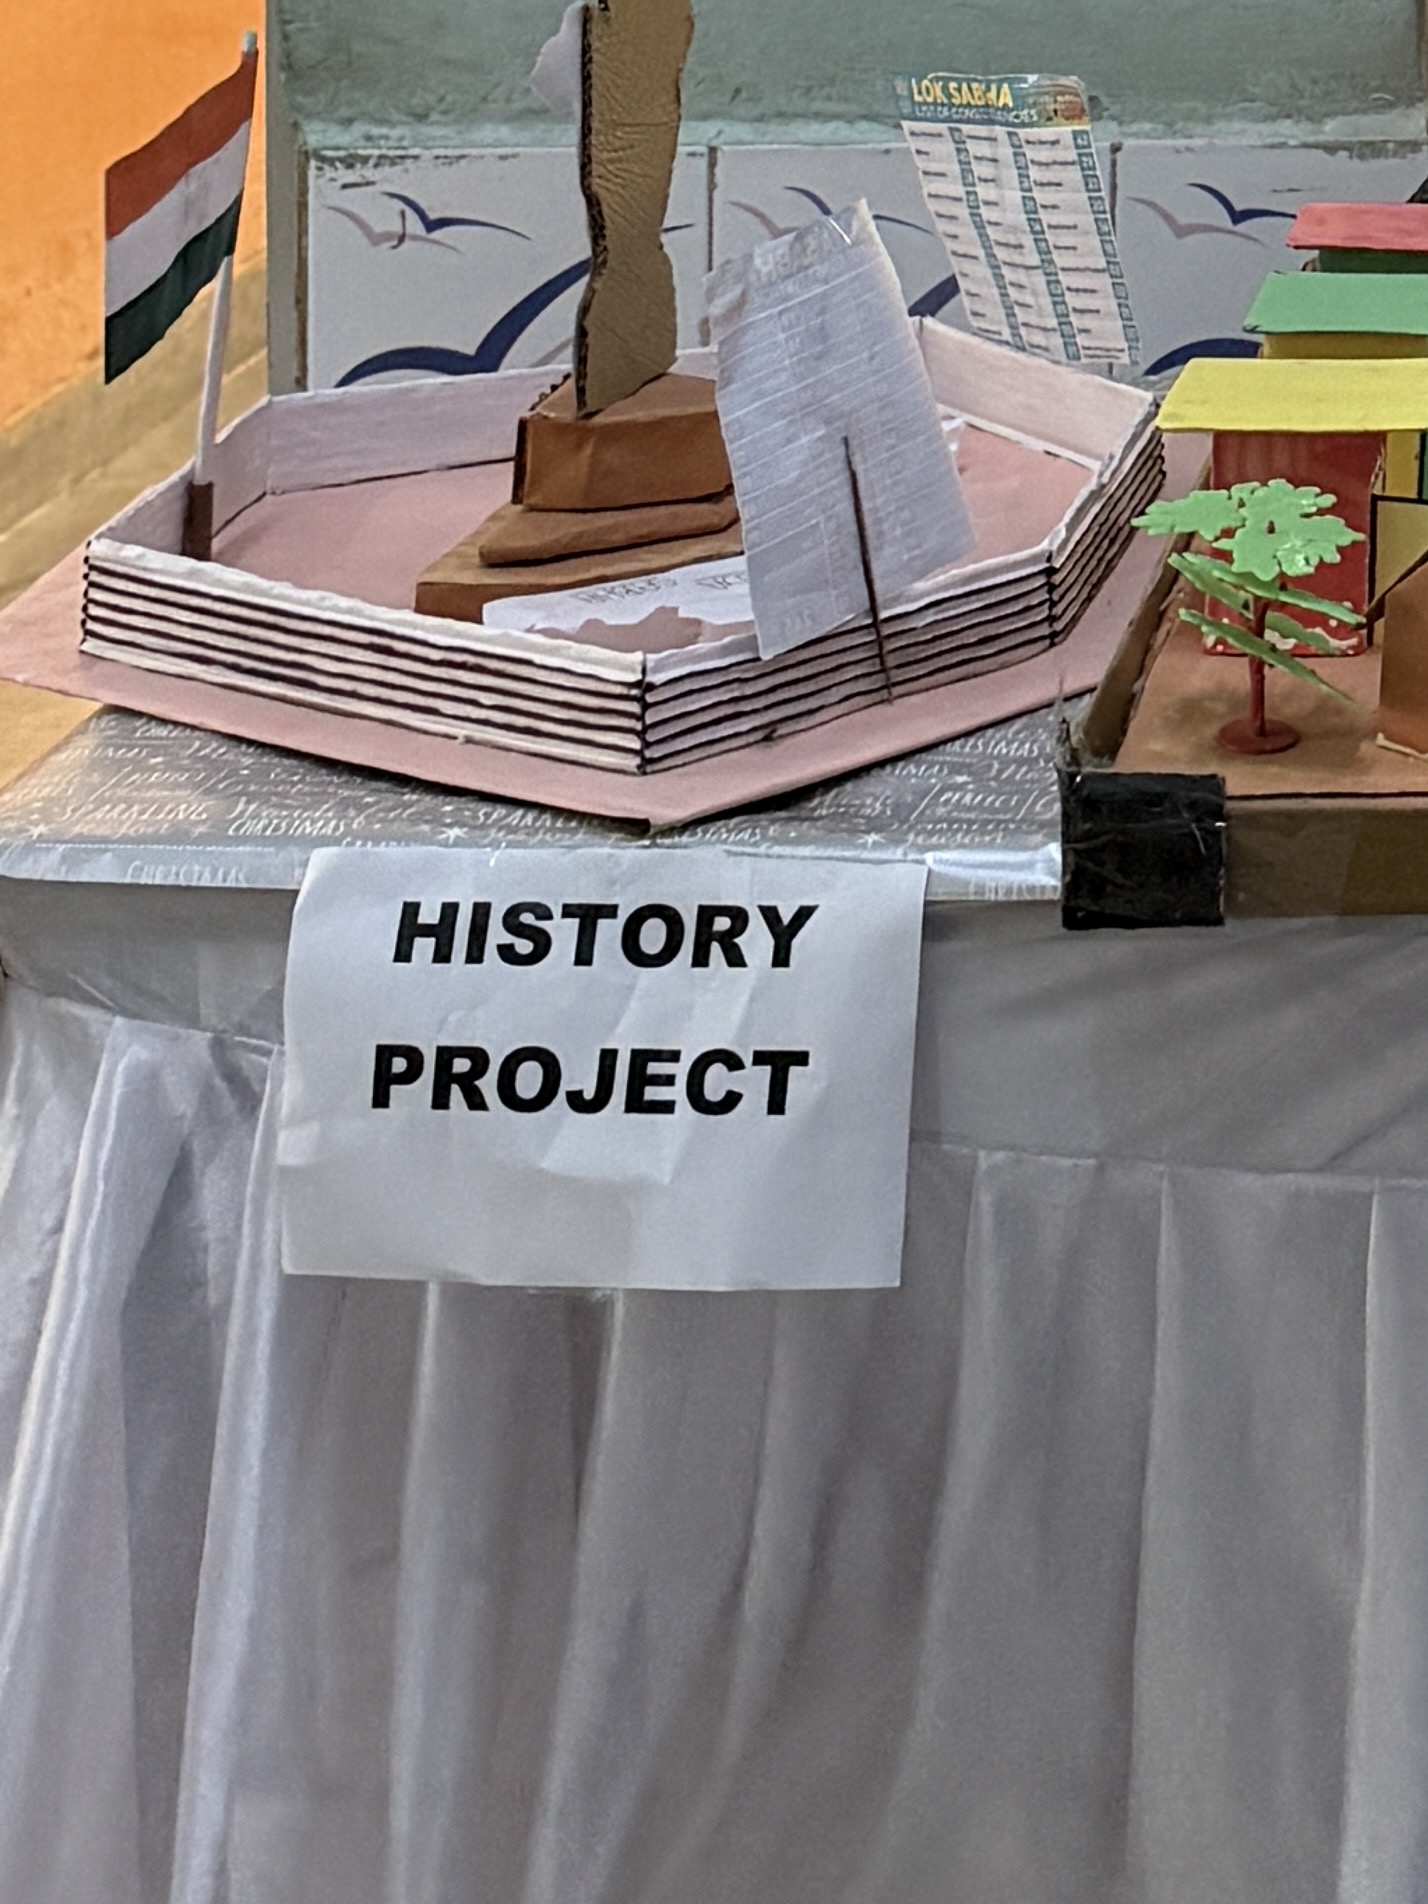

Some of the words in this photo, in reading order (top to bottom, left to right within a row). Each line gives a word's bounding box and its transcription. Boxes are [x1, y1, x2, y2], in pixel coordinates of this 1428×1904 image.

[911, 77, 948, 104] LOK
[949, 80, 1014, 108] SABHA
[392, 901, 819, 968] HISTORY
[370, 1044, 810, 1117] PROJECT
